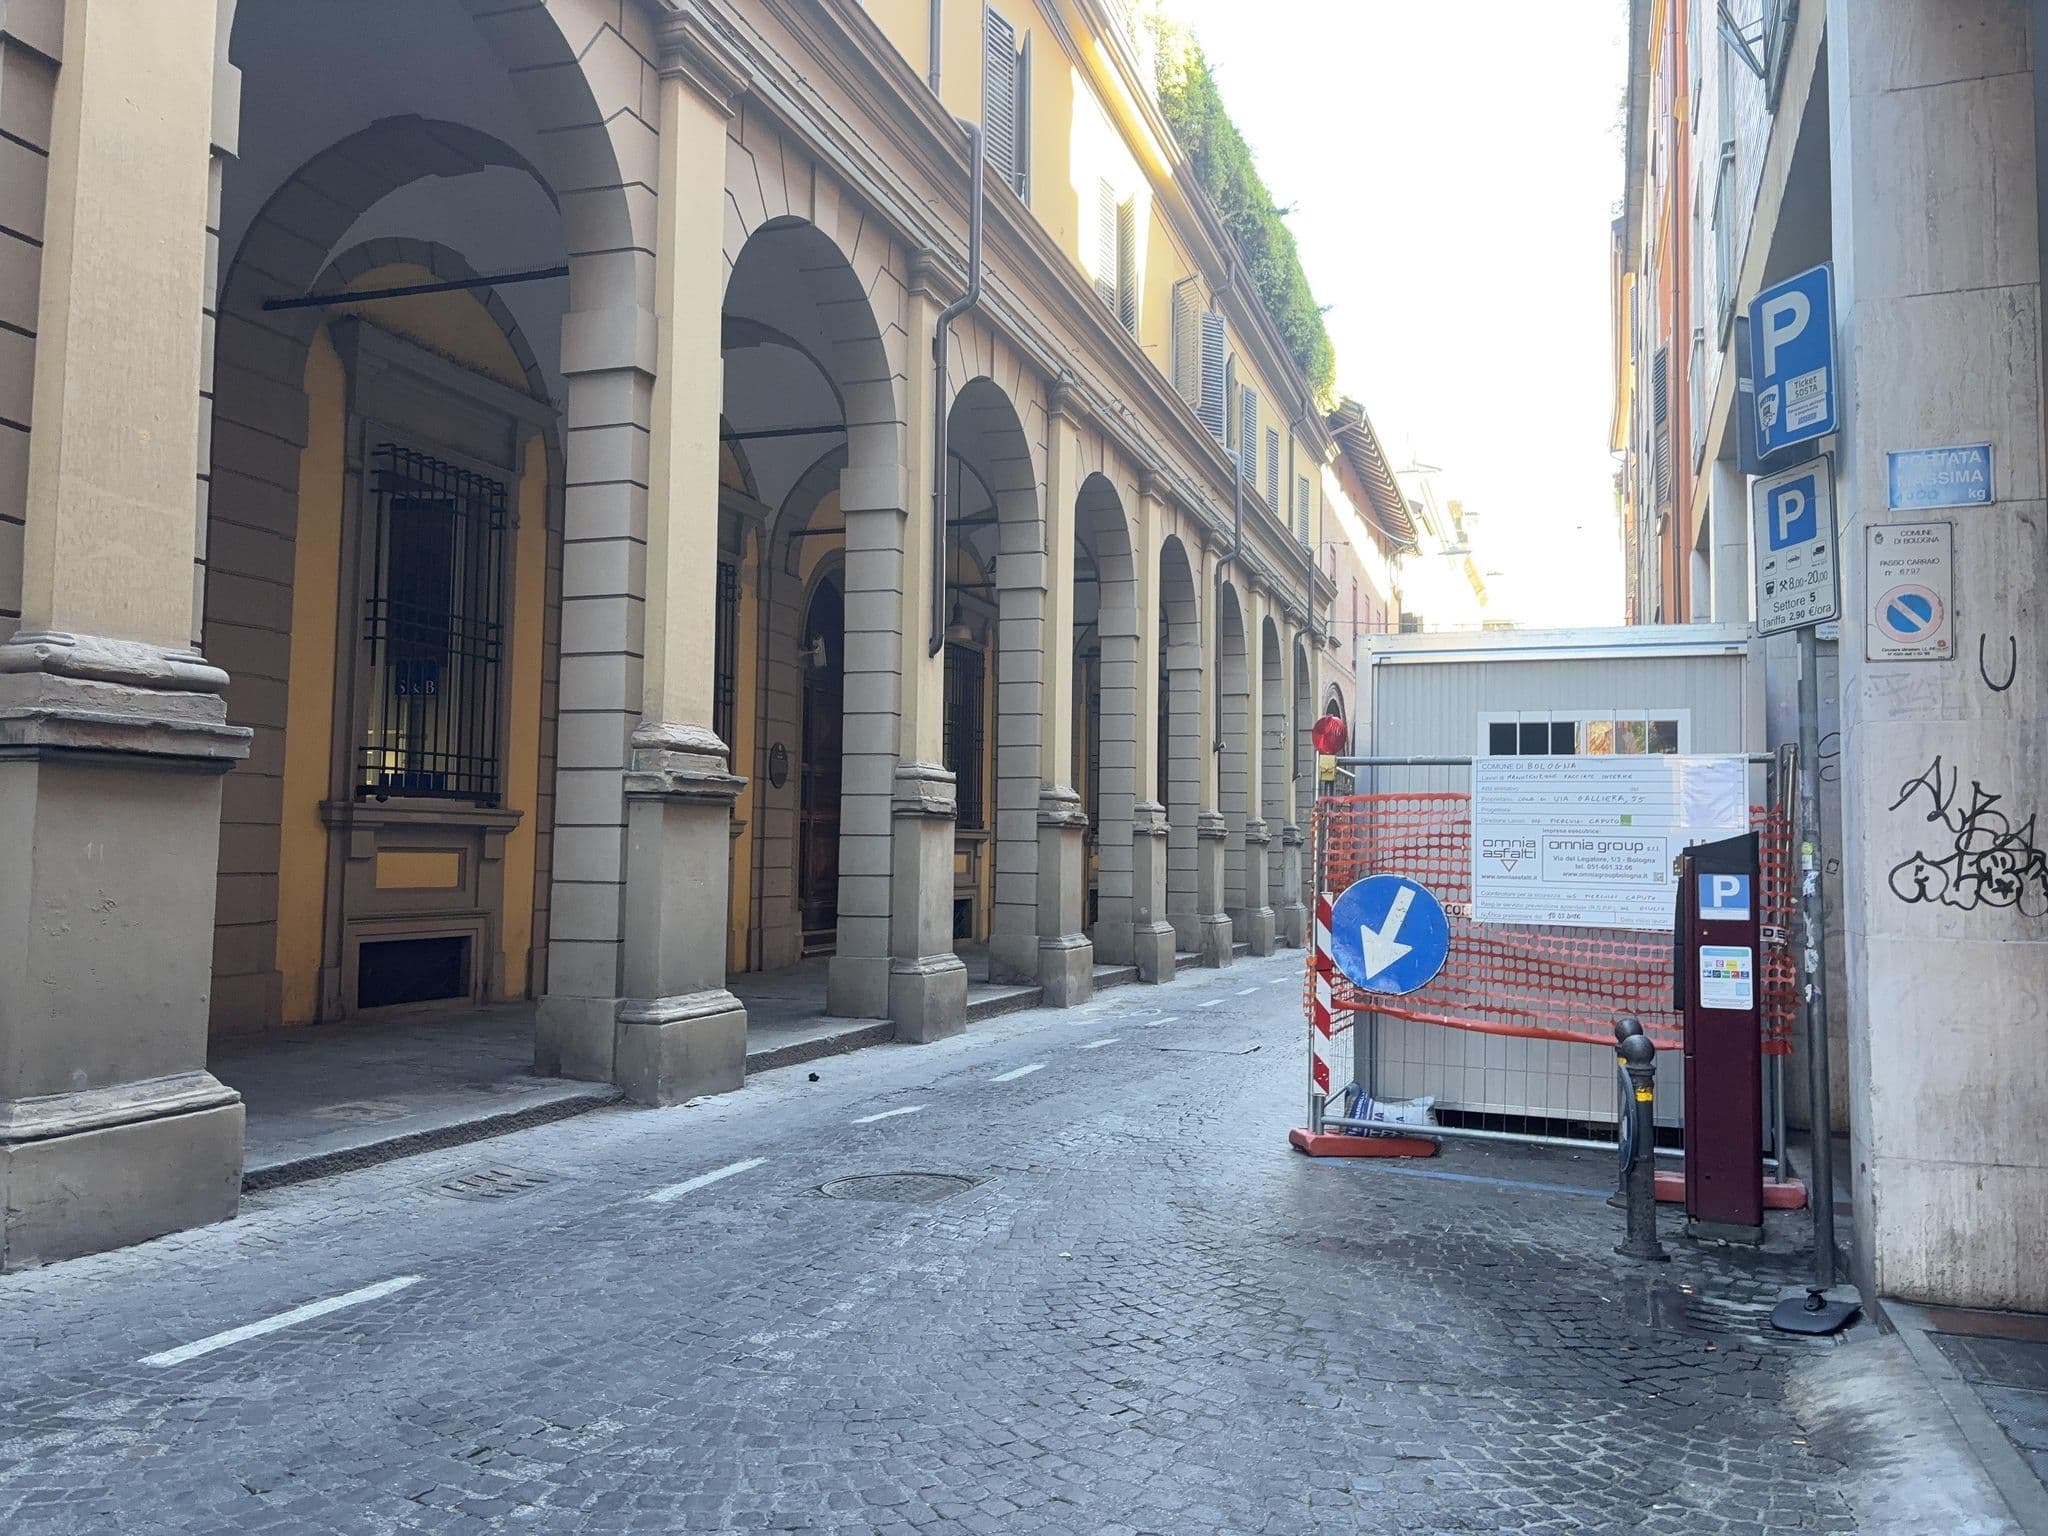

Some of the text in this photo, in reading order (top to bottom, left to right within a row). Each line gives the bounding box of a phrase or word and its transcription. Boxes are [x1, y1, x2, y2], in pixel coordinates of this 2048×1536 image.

[1762, 291, 1810, 378] P
[1794, 376, 1817, 389] Ticket
[1795, 384, 1818, 398] SOSTA
[1968, 488, 1986, 501] kg
[1777, 489, 1805, 541] P
[1900, 529, 1932, 537] COMUNE
[1907, 557, 1940, 565] CARRAIO
[1773, 592, 1816, 613] Settore 5
[1762, 615, 1786, 629] Tariffa
[1527, 761, 1577, 770] BOLOGNA
[1483, 836, 1536, 848] omnia
[1549, 838, 1594, 851] omnia
[1598, 841, 1644, 854] group
[1483, 847, 1536, 859] asfalti
[1713, 875, 1741, 907] P
